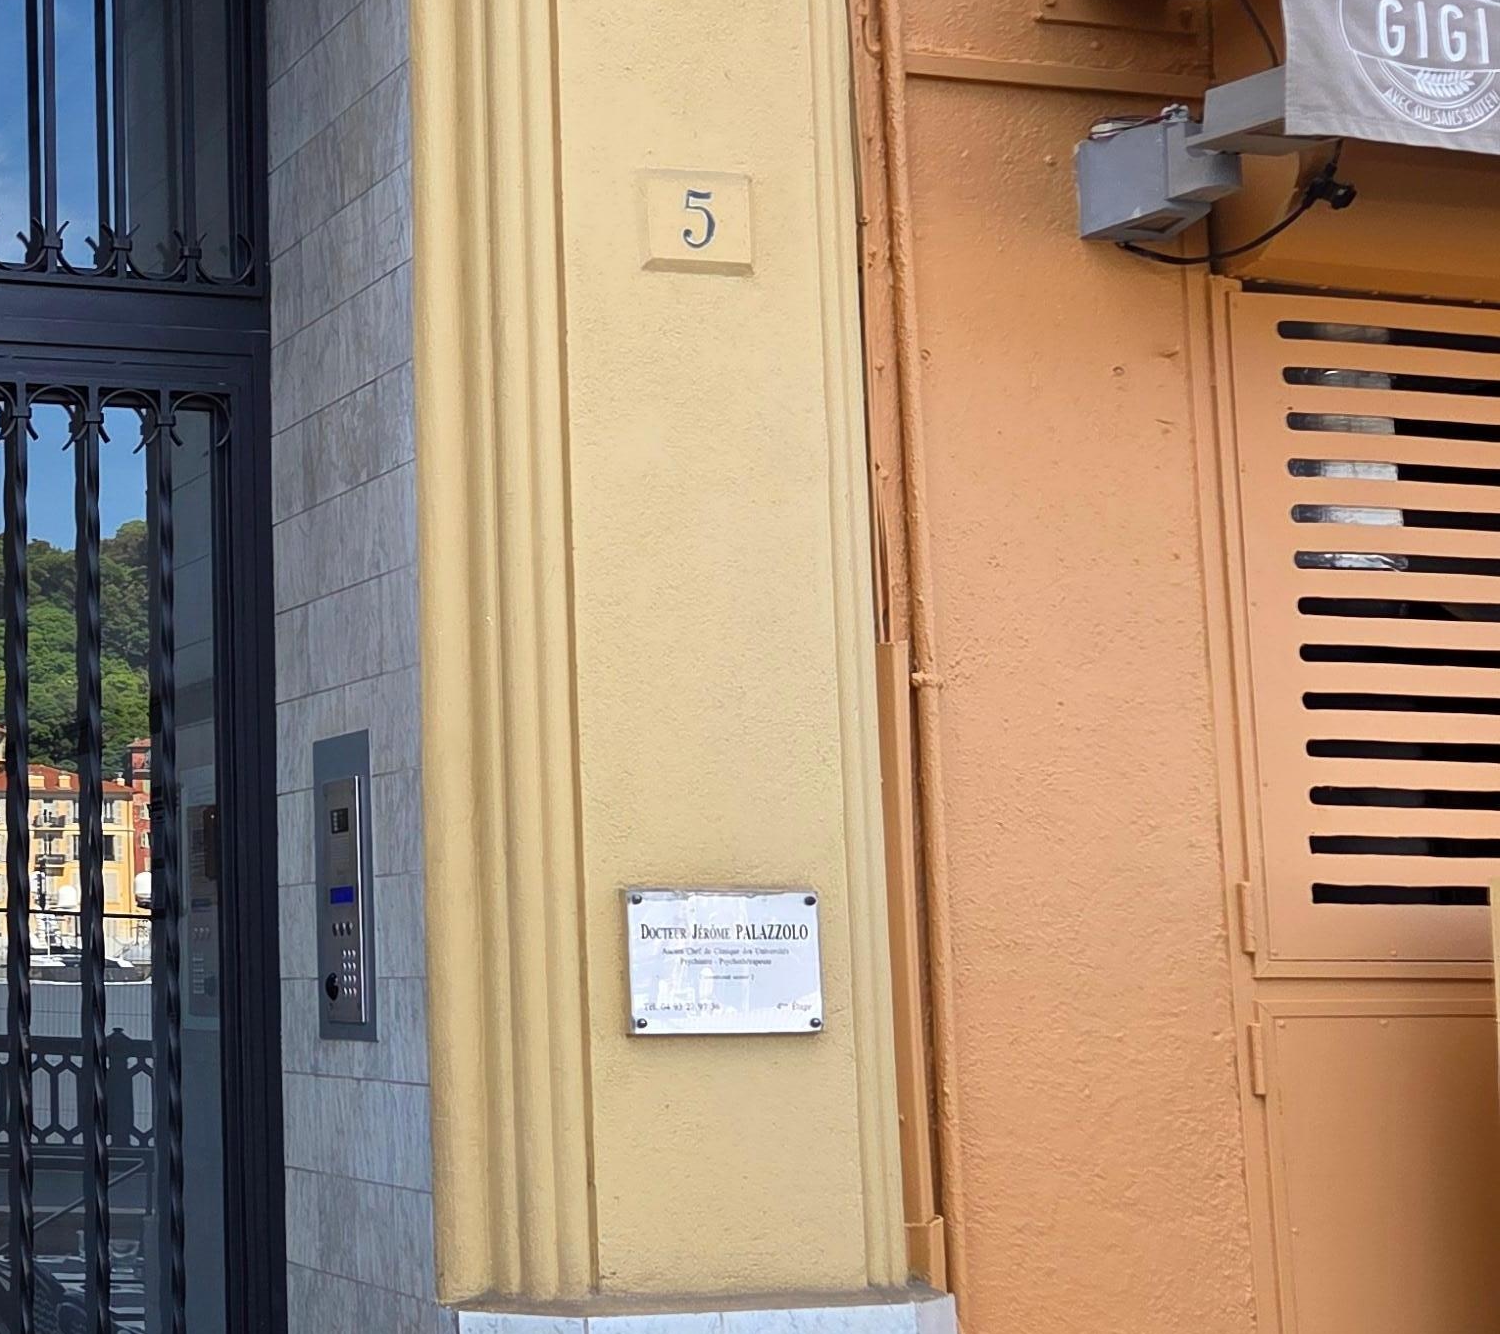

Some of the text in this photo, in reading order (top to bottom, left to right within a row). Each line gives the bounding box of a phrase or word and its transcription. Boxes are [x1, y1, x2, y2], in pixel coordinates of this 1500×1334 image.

[1383, 87, 1414, 114] AVEC
[1415, 106, 1431, 122] OU
[1433, 109, 1463, 126] SANS
[683, 189, 715, 248] 5
[736, 923, 809, 940] PALAZZOLO
